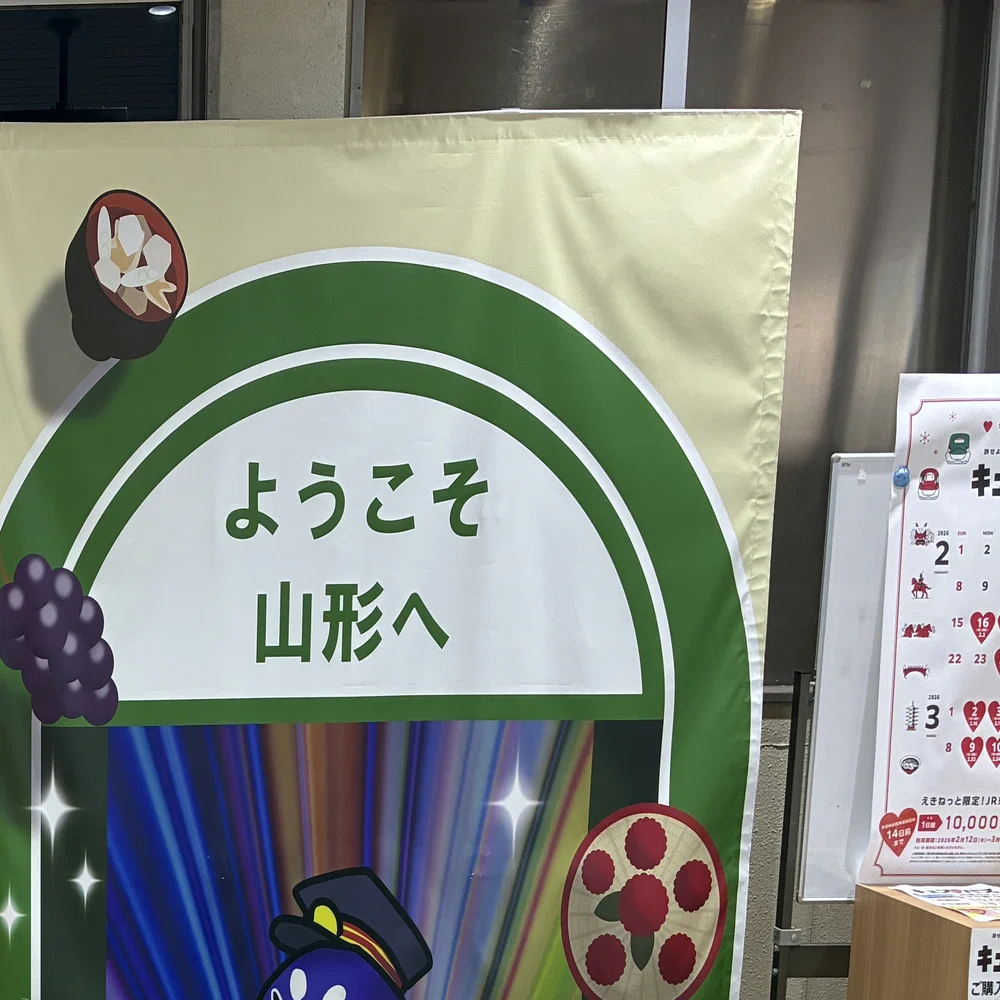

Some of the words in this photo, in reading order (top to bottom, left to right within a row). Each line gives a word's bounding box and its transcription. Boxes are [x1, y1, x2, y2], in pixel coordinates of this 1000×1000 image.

[226, 458, 489, 540] ようこそ
[934, 540, 950, 566] 2
[958, 544, 964, 555] 1
[983, 544, 991, 555] 2
[955, 581, 963, 591] 8
[982, 581, 989, 591] 9
[256, 580, 450, 663] 山形へ
[951, 617, 964, 628] 15
[977, 617, 989, 628] 16
[948, 653, 962, 664] 22
[973, 653, 987, 664] 23
[925, 704, 940, 730] 3
[948, 706, 954, 717] 1
[971, 706, 978, 717] 2
[945, 742, 952, 753] 8
[969, 742, 976, 753] 9
[921, 796, 1000, 806] えきねっと限定!JR
[886, 827, 912, 840] 14日前
[893, 839, 905, 847] まで
